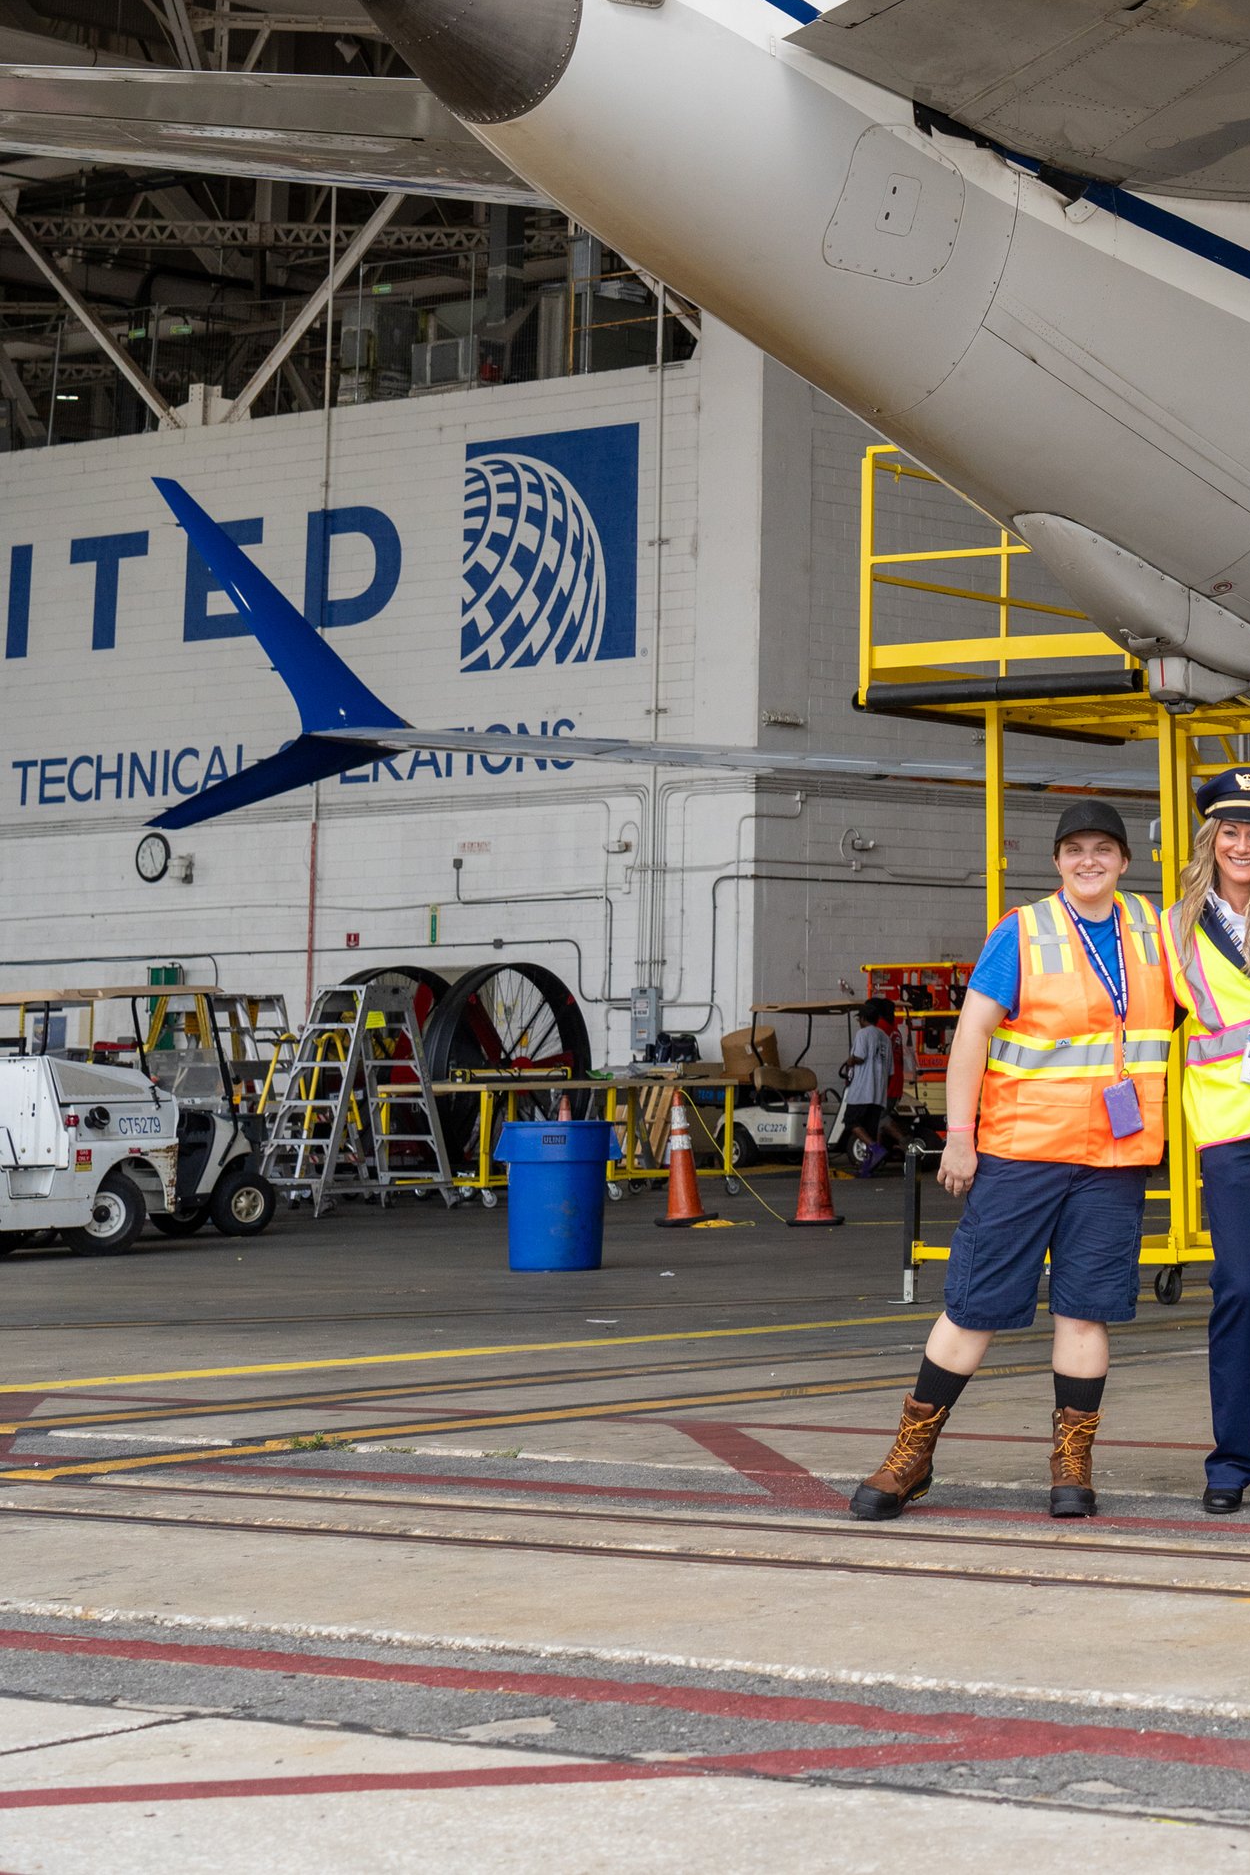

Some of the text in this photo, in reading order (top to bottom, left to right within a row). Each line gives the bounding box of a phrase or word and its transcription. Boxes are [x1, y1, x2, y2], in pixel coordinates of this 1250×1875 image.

[118, 1116, 161, 1135] CT5279
[757, 1123, 788, 1133] GC2276
[543, 1136, 565, 1144] ULINE
